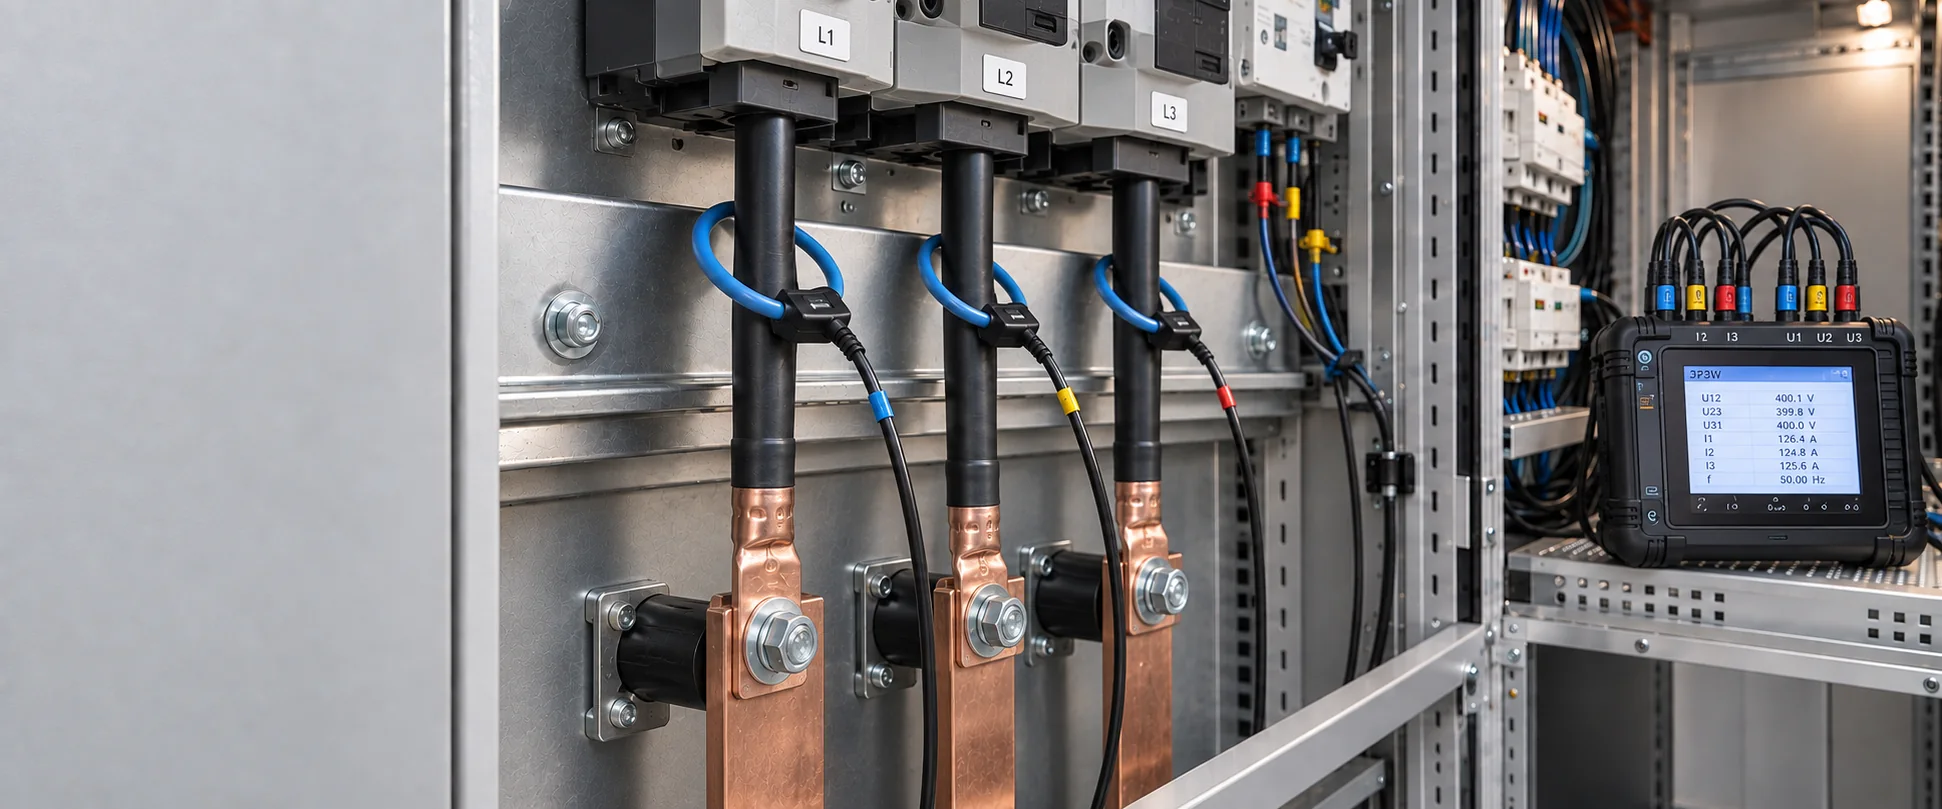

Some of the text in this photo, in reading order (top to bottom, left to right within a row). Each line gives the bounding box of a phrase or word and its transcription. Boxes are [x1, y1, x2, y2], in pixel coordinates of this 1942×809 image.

[818, 26, 833, 46] L1
[998, 68, 1014, 86] L2
[1164, 104, 1176, 121] L3
[1696, 332, 1708, 342] I2
[1727, 332, 1738, 342] I3
[1787, 332, 1801, 342] U1
[1817, 332, 1832, 342] U2
[1847, 332, 1862, 342] U3
[1702, 394, 1814, 402] U12 400.1 V
[1702, 408, 1815, 416] U23 399.8 V
[1704, 421, 1816, 429] U31 400.0 V
[1704, 435, 1817, 443] I1 126.4 A
[1705, 448, 1818, 456] I2 124.8 A
[1706, 462, 1819, 470] I3 125.6 A
[1707, 475, 1825, 484] f 50.00 Hz
